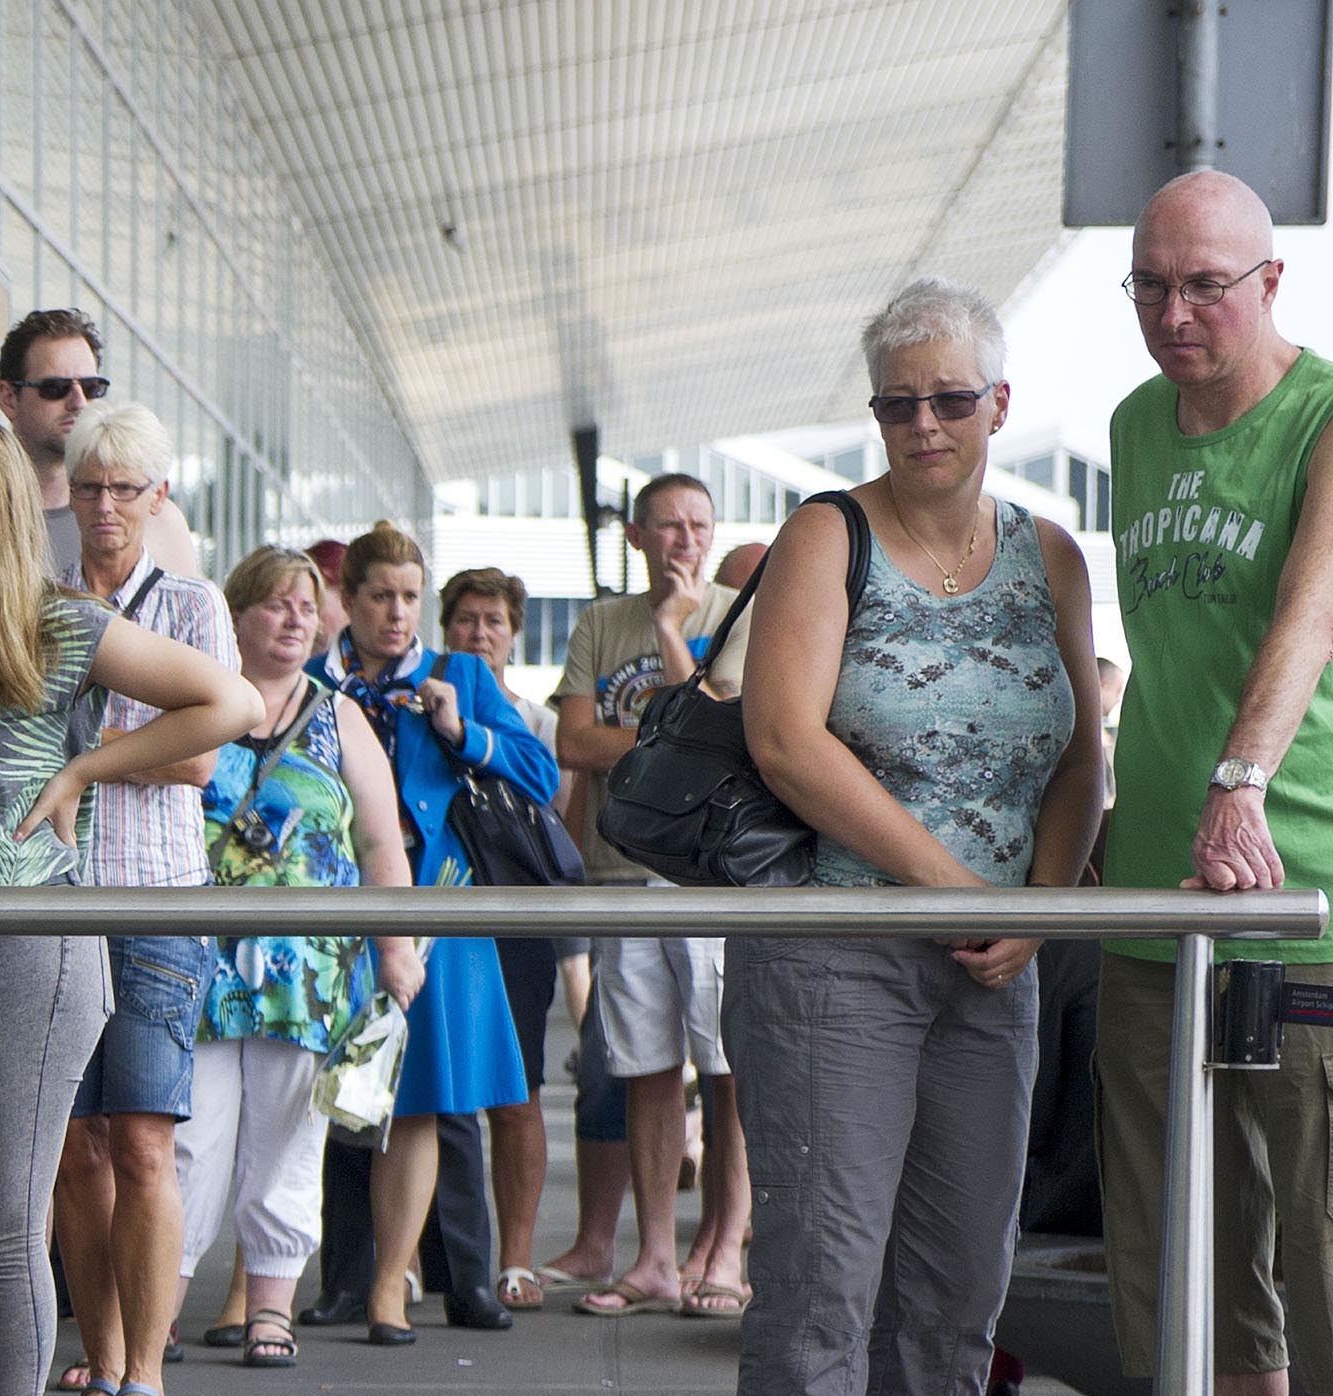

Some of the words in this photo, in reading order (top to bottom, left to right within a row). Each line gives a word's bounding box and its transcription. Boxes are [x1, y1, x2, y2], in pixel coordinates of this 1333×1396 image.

[1167, 470, 1205, 500] THE
[1119, 504, 1265, 567] TROPICANA
[1182, 551, 1226, 599] Club
